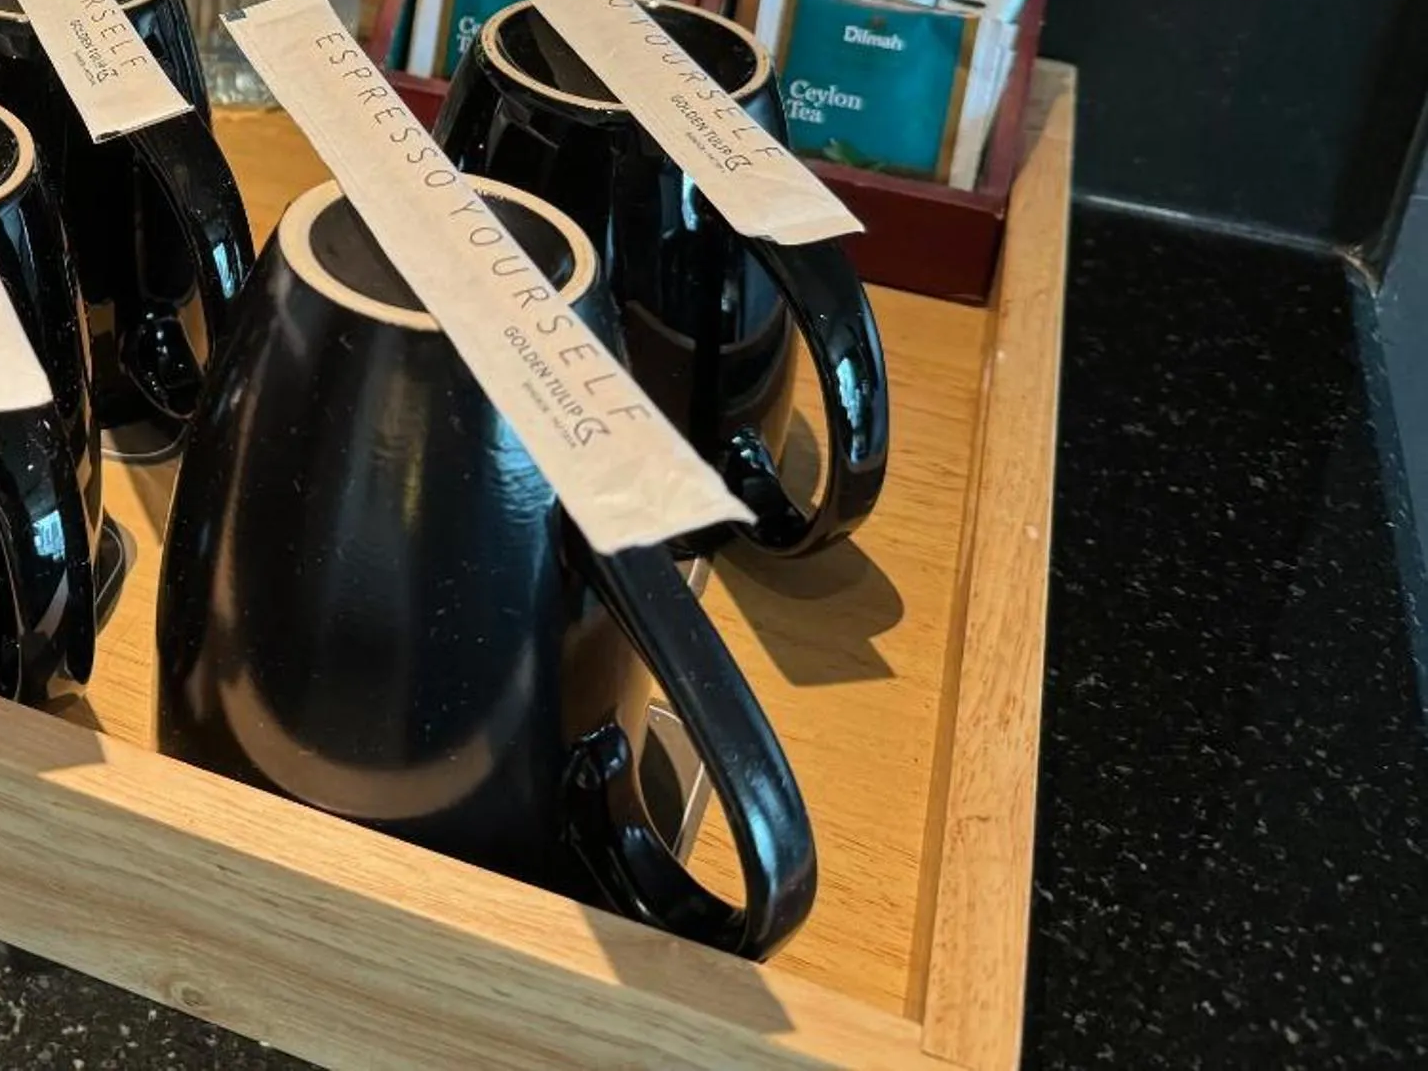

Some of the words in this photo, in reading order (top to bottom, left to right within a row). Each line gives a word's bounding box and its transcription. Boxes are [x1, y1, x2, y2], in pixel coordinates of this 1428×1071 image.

[843, 25, 906, 52] Dilmah
[790, 79, 864, 112] Ceylon
[787, 99, 824, 125] Tea
[503, 325, 553, 380] GOLDEN
[545, 373, 585, 419] TULIP
